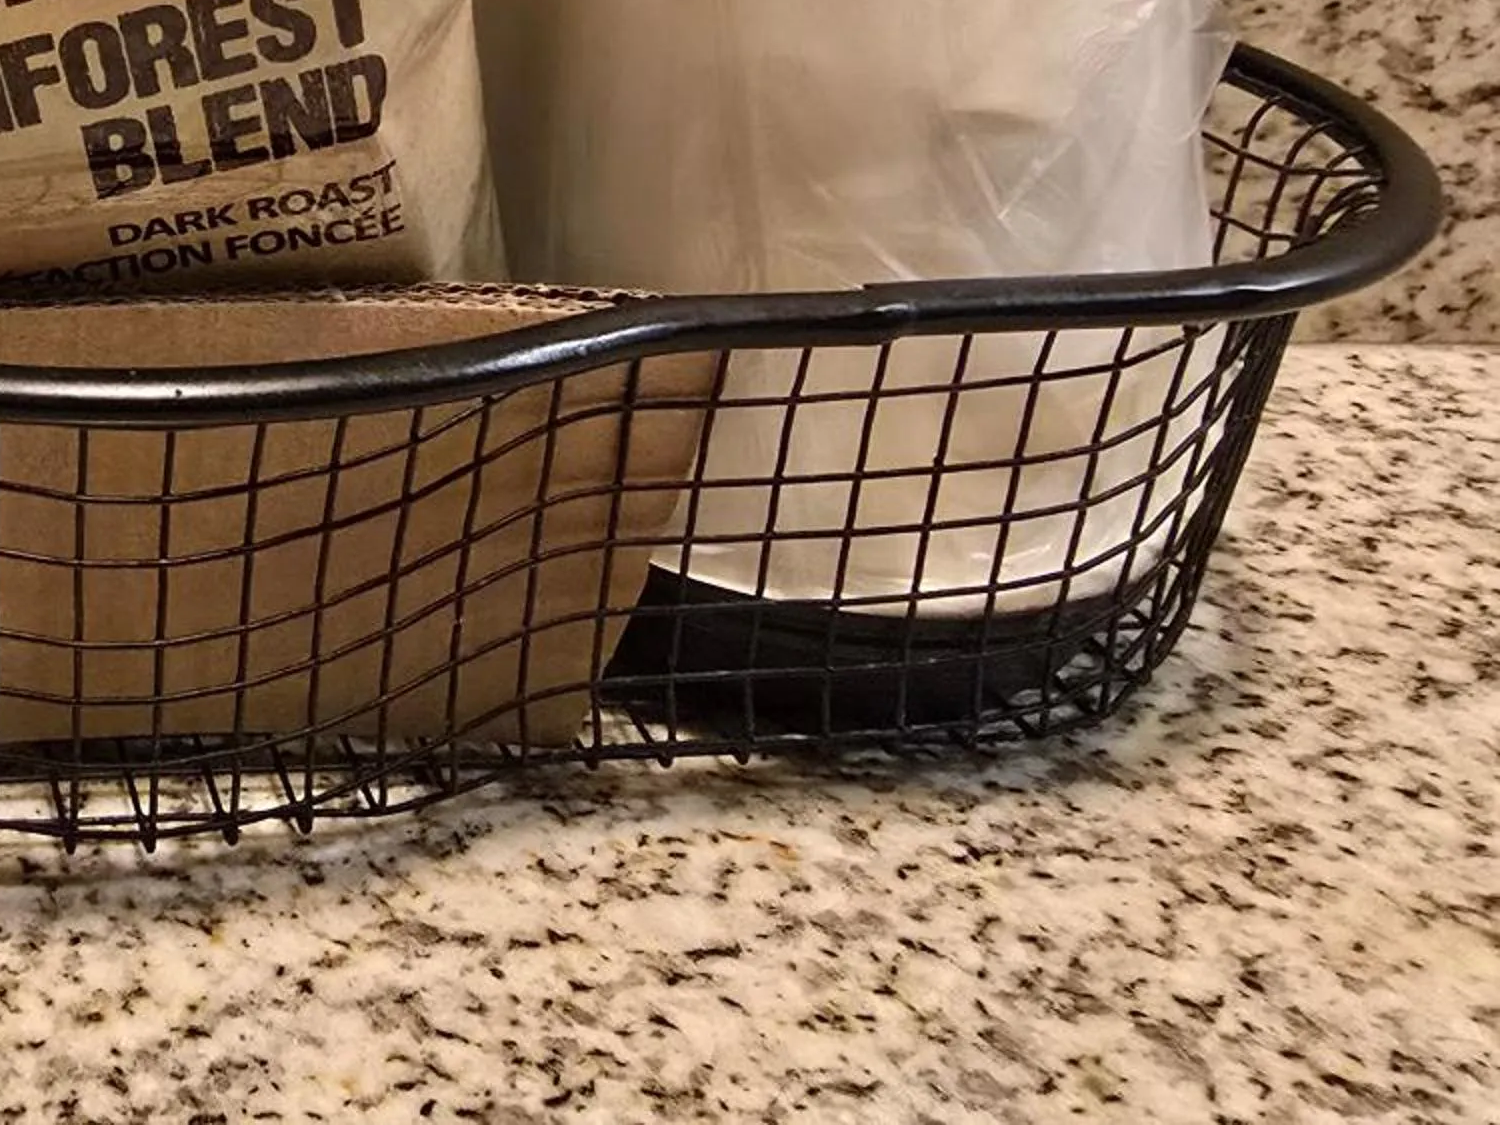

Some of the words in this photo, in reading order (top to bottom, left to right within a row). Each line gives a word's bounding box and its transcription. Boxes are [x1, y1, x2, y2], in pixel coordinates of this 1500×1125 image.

[79, 53, 388, 200] BLEND
[108, 203, 238, 247] DARK
[247, 160, 397, 221] ROAST
[225, 203, 405, 260] FONCÉE
